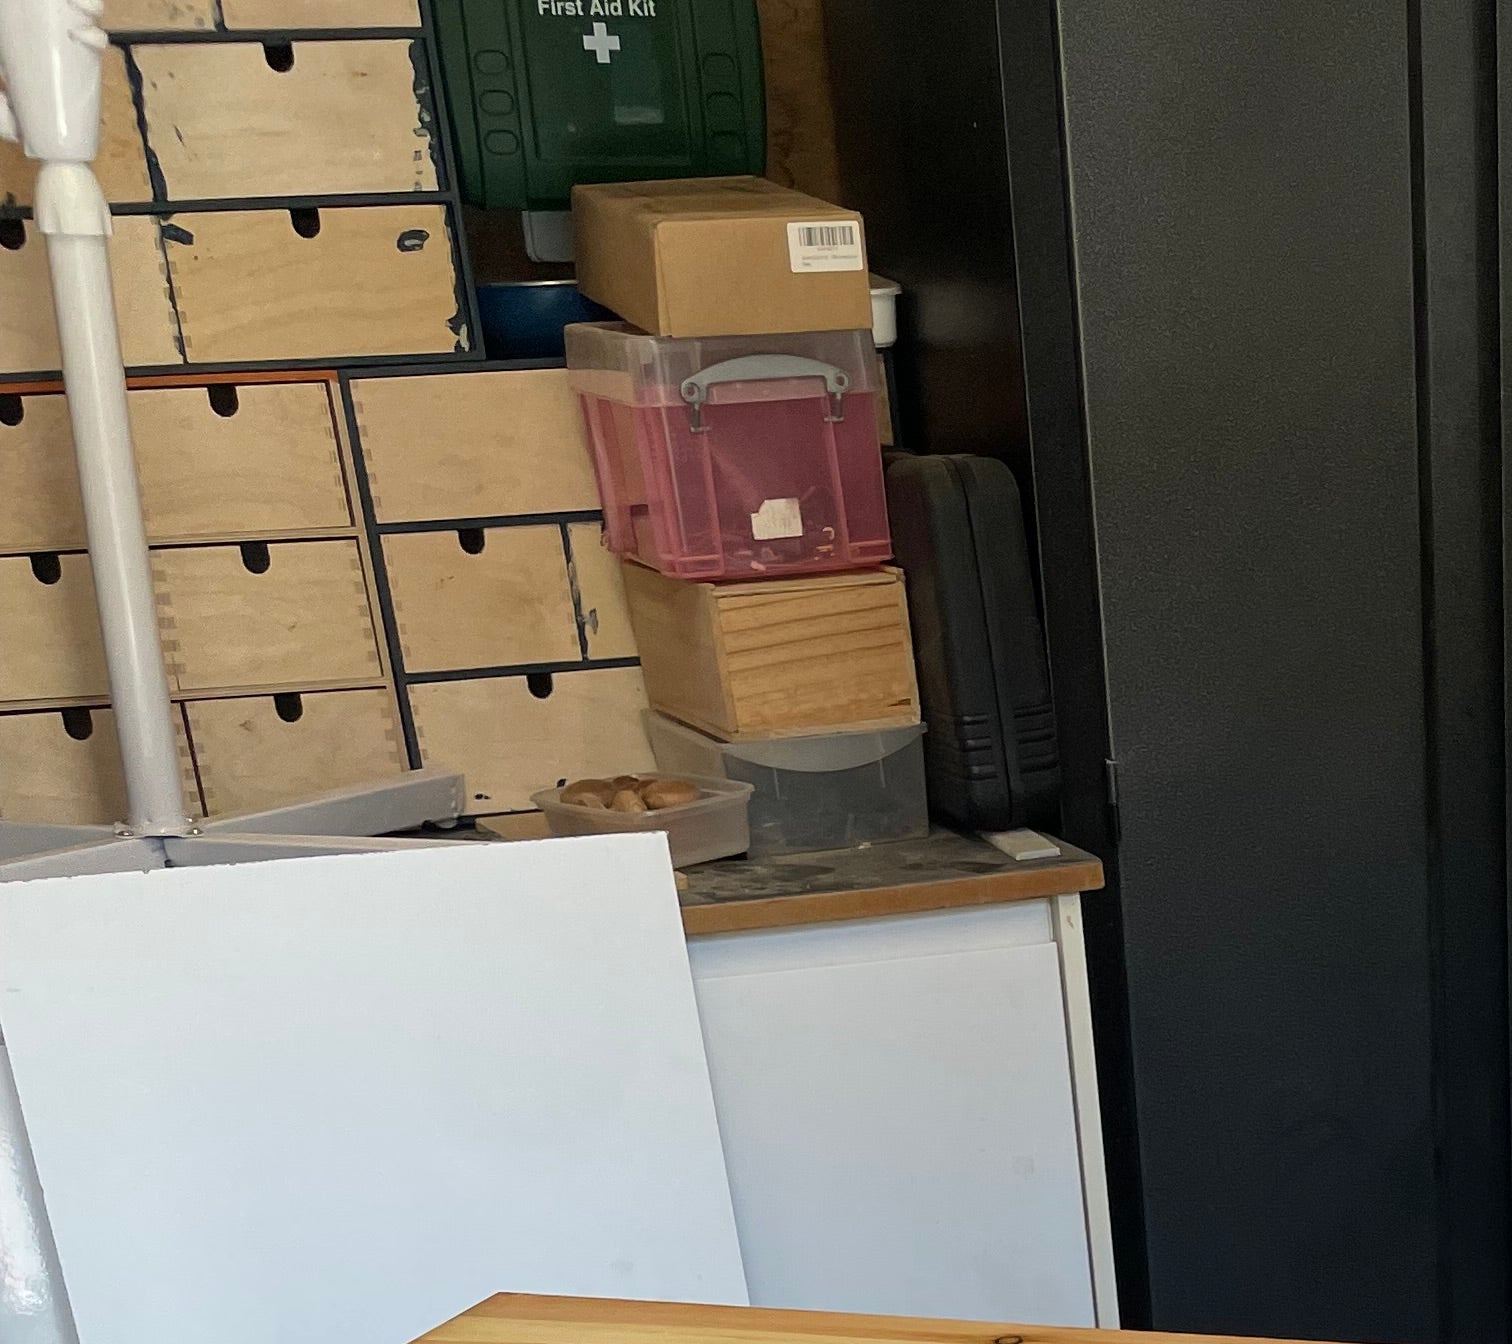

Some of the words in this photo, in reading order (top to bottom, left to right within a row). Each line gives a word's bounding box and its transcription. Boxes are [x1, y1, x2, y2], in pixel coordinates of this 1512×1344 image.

[537, 0, 584, 16] First
[590, 0, 622, 16] Aid
[628, 0, 656, 17] Kit
